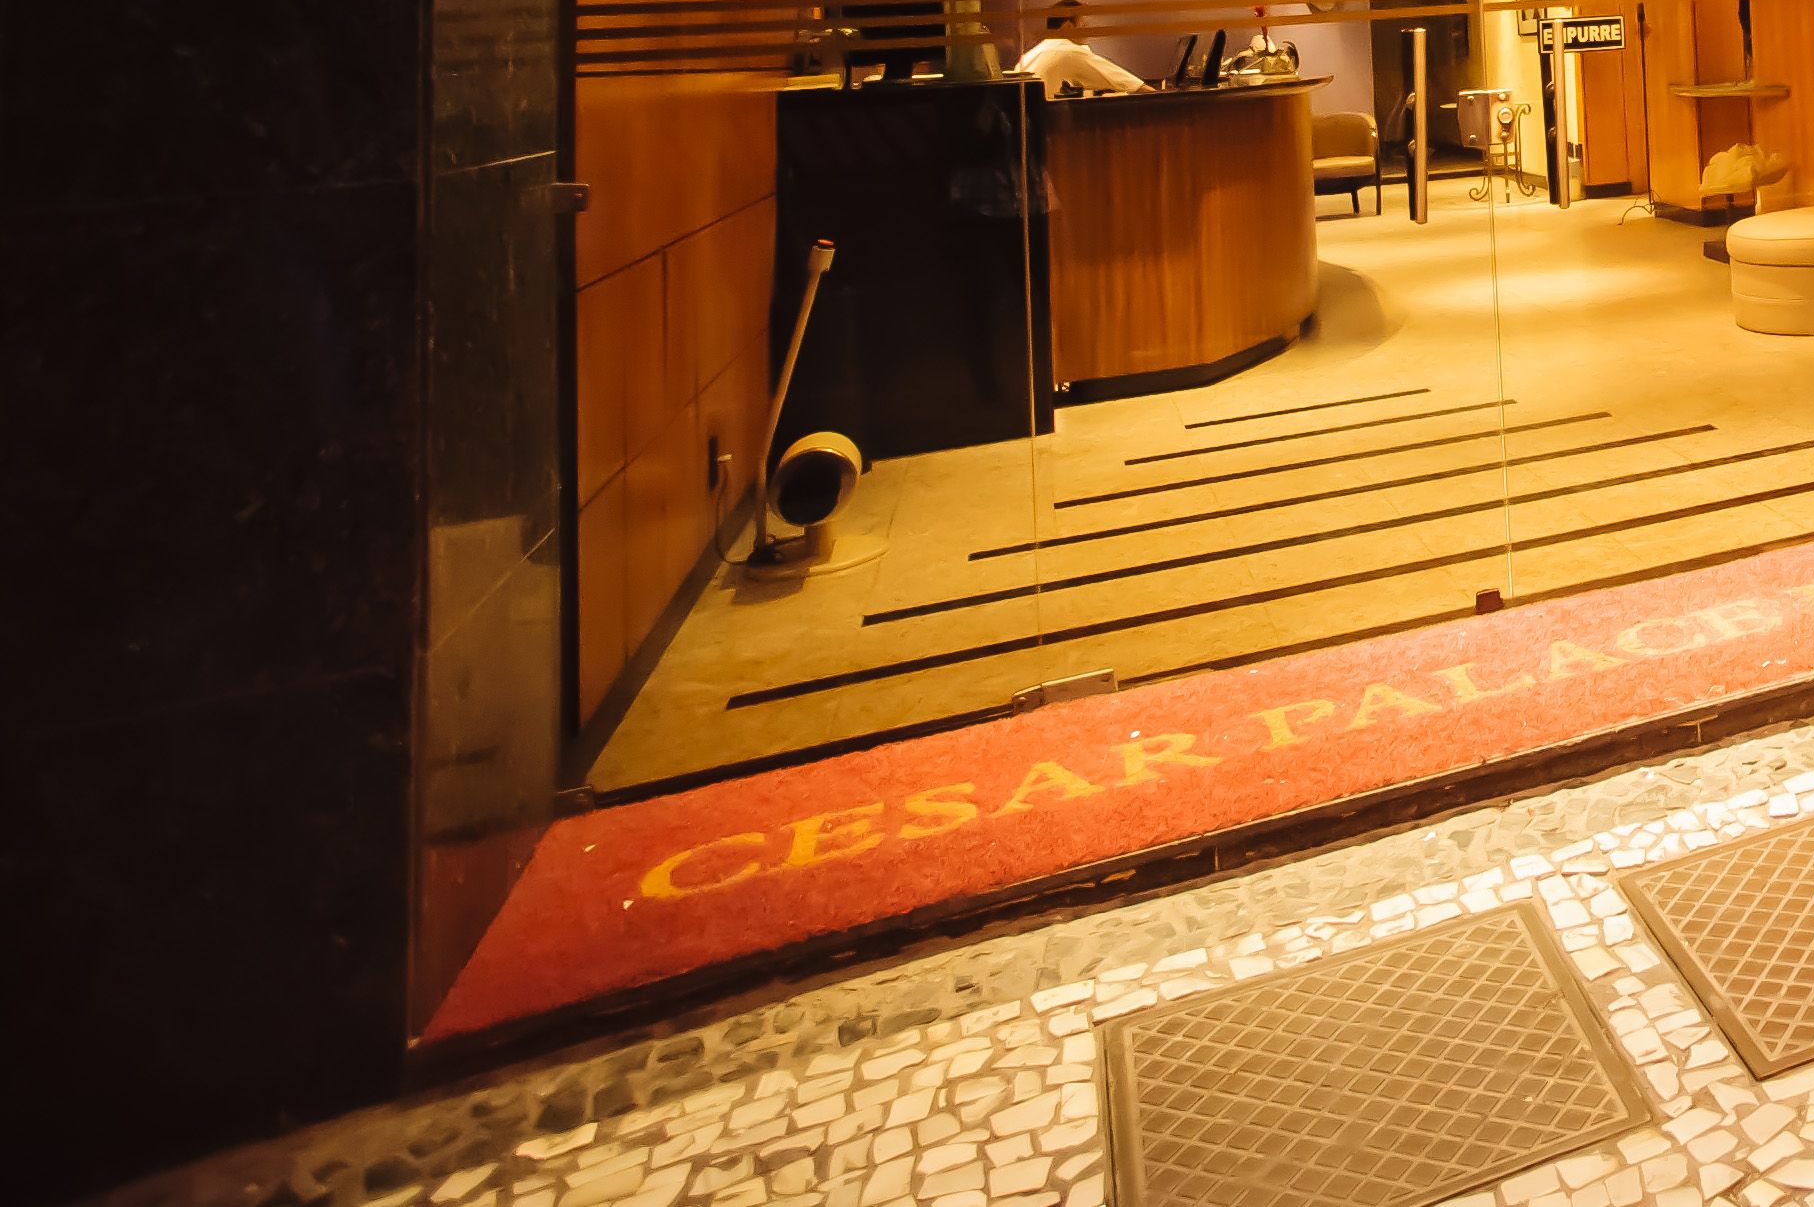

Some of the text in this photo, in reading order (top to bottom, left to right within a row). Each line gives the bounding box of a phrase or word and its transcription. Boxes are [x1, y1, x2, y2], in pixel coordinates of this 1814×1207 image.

[1544, 24, 1621, 43] EPURRE
[640, 732, 1223, 900] CESAR
[1255, 598, 1784, 751] PALACE
